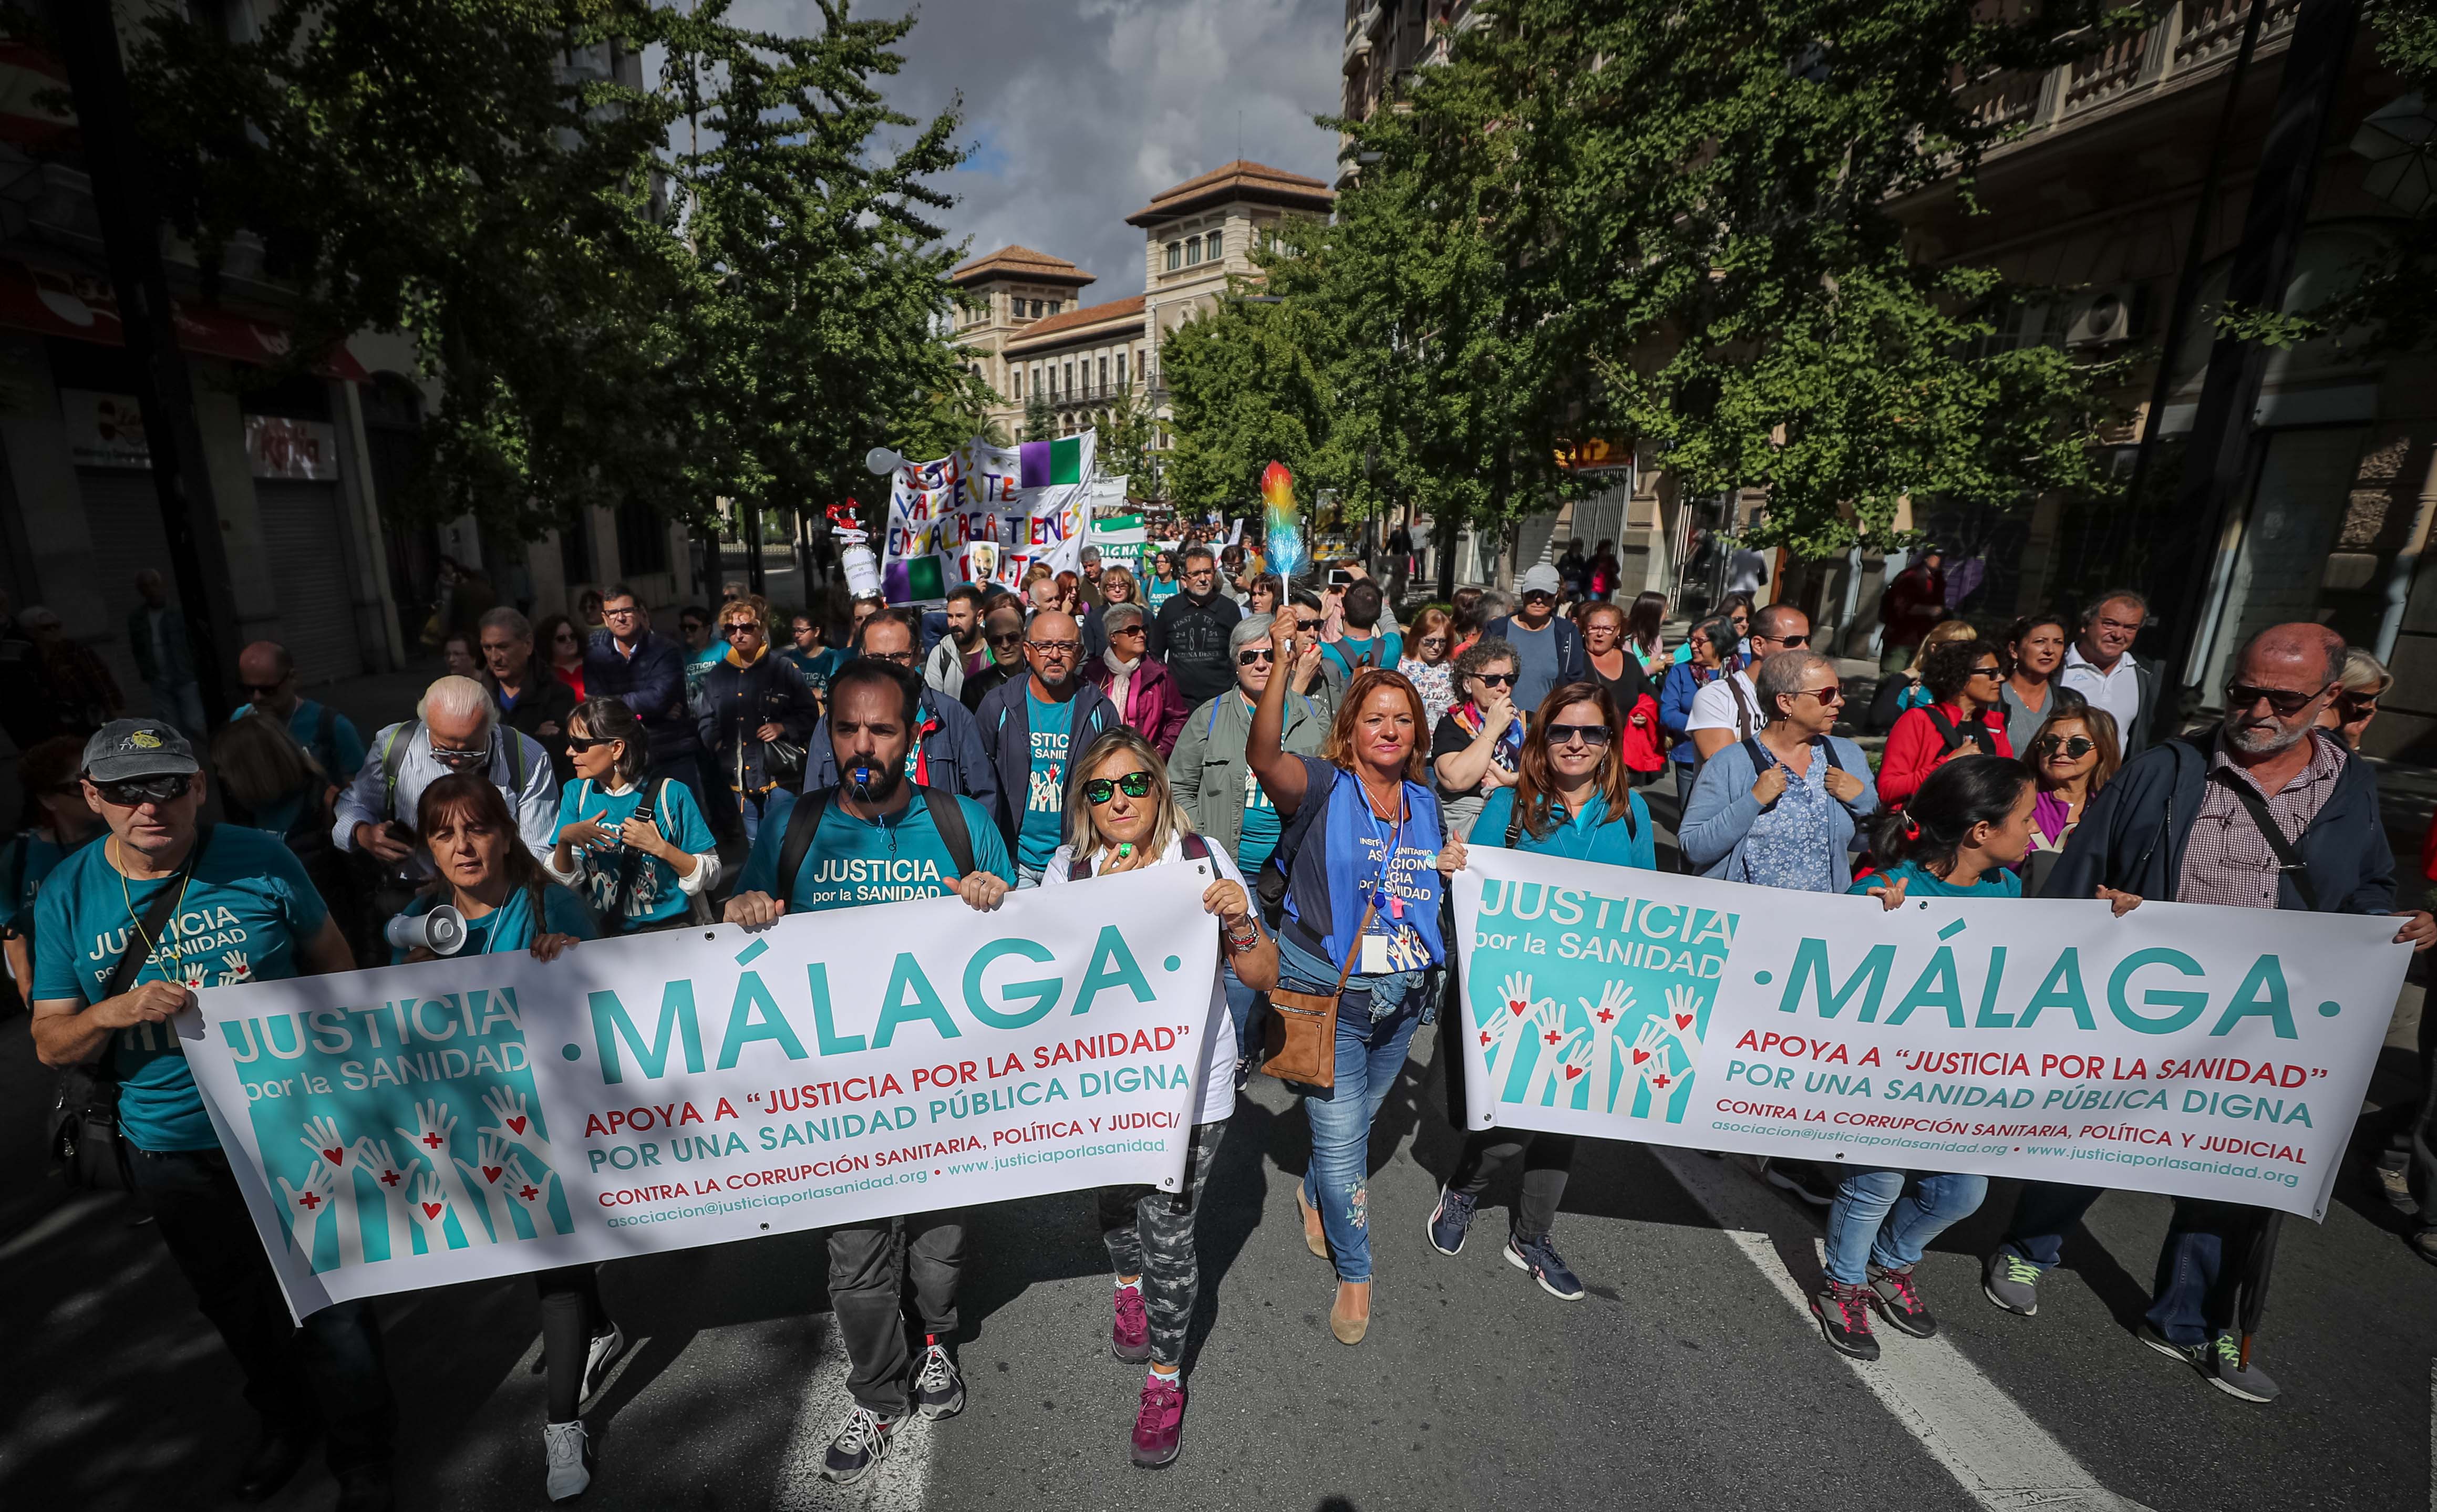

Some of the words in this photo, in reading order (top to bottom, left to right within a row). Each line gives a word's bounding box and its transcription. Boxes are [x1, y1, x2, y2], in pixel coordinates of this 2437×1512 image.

[813, 858, 941, 884] JUSTICIA
[813, 890, 837, 905] por
[839, 888, 852, 900] la
[856, 885, 941, 901] SANIDAD
[145, 928, 247, 965] SANIDAD
[1479, 880, 1732, 950] JUSTICIA
[1471, 930, 1517, 952] por
[1523, 932, 1546, 955] la
[1557, 931, 1727, 979] SANIDAD
[1778, 917, 2299, 1040] MÁLAGA
[232, 987, 523, 1063] JUSTICIA
[587, 924, 1157, 1086] MÁLAGA
[241, 1072, 293, 1107] por
[300, 1072, 333, 1095] la
[339, 1042, 530, 1091] SANIDAD
[584, 1101, 705, 1139] APOYA
[714, 1096, 740, 1122] A
[746, 1073, 904, 1115] “JUSTICIA
[912, 1060, 979, 1092] POR
[987, 1052, 1025, 1079] LA
[1033, 1024, 1190, 1069] SANIDAD”
[1734, 1029, 1849, 1065] APOYA
[1858, 1047, 1882, 1068] A
[1895, 1049, 2031, 1077] “JUSTICIA
[2041, 1053, 2106, 1081] POR
[2112, 1057, 2147, 1081] LA
[2155, 1058, 2329, 1090] SANIDAD”
[586, 1142, 663, 1175] POR
[670, 1131, 750, 1163] UNA
[758, 1105, 917, 1151] SANIDAD
[930, 1077, 1069, 1124] PÚBLICA
[1079, 1063, 1190, 1099] DIGNA
[1725, 1059, 1795, 1090] POR
[1804, 1071, 1872, 1098] UNA
[1883, 1079, 2035, 1109] SANIDAD
[2041, 1082, 2169, 1111] PÚBLICA
[2181, 1089, 2314, 1130] DIGNA
[598, 1182, 689, 1208] CONTRA
[694, 1178, 722, 1196] LA
[726, 1153, 870, 1190] CORRUPCIÓN
[874, 1133, 988, 1167] SANITARIA,
[992, 1121, 1084, 1147] POLÍTICA
[1088, 1117, 1102, 1134] Y
[1711, 1119, 2008, 1156] asociacion@justiciaporlasanidad.org
[2027, 1144, 2300, 1188] www.justiciaporlasanidad.org
[1715, 1098, 1798, 1121] CONTRA
[1803, 1109, 1827, 1124] LA
[1833, 1111, 1969, 1136] CORRUPCIÓN
[1971, 1123, 2072, 1140] SANITARIA,
[2079, 1122, 2173, 1147] POLÍTICA
[2181, 1132, 2196, 1148] Y
[2198, 1135, 2308, 1165] JUDICIAL
[607, 1169, 928, 1229] asociacion@justiciaporlasanidad.org
